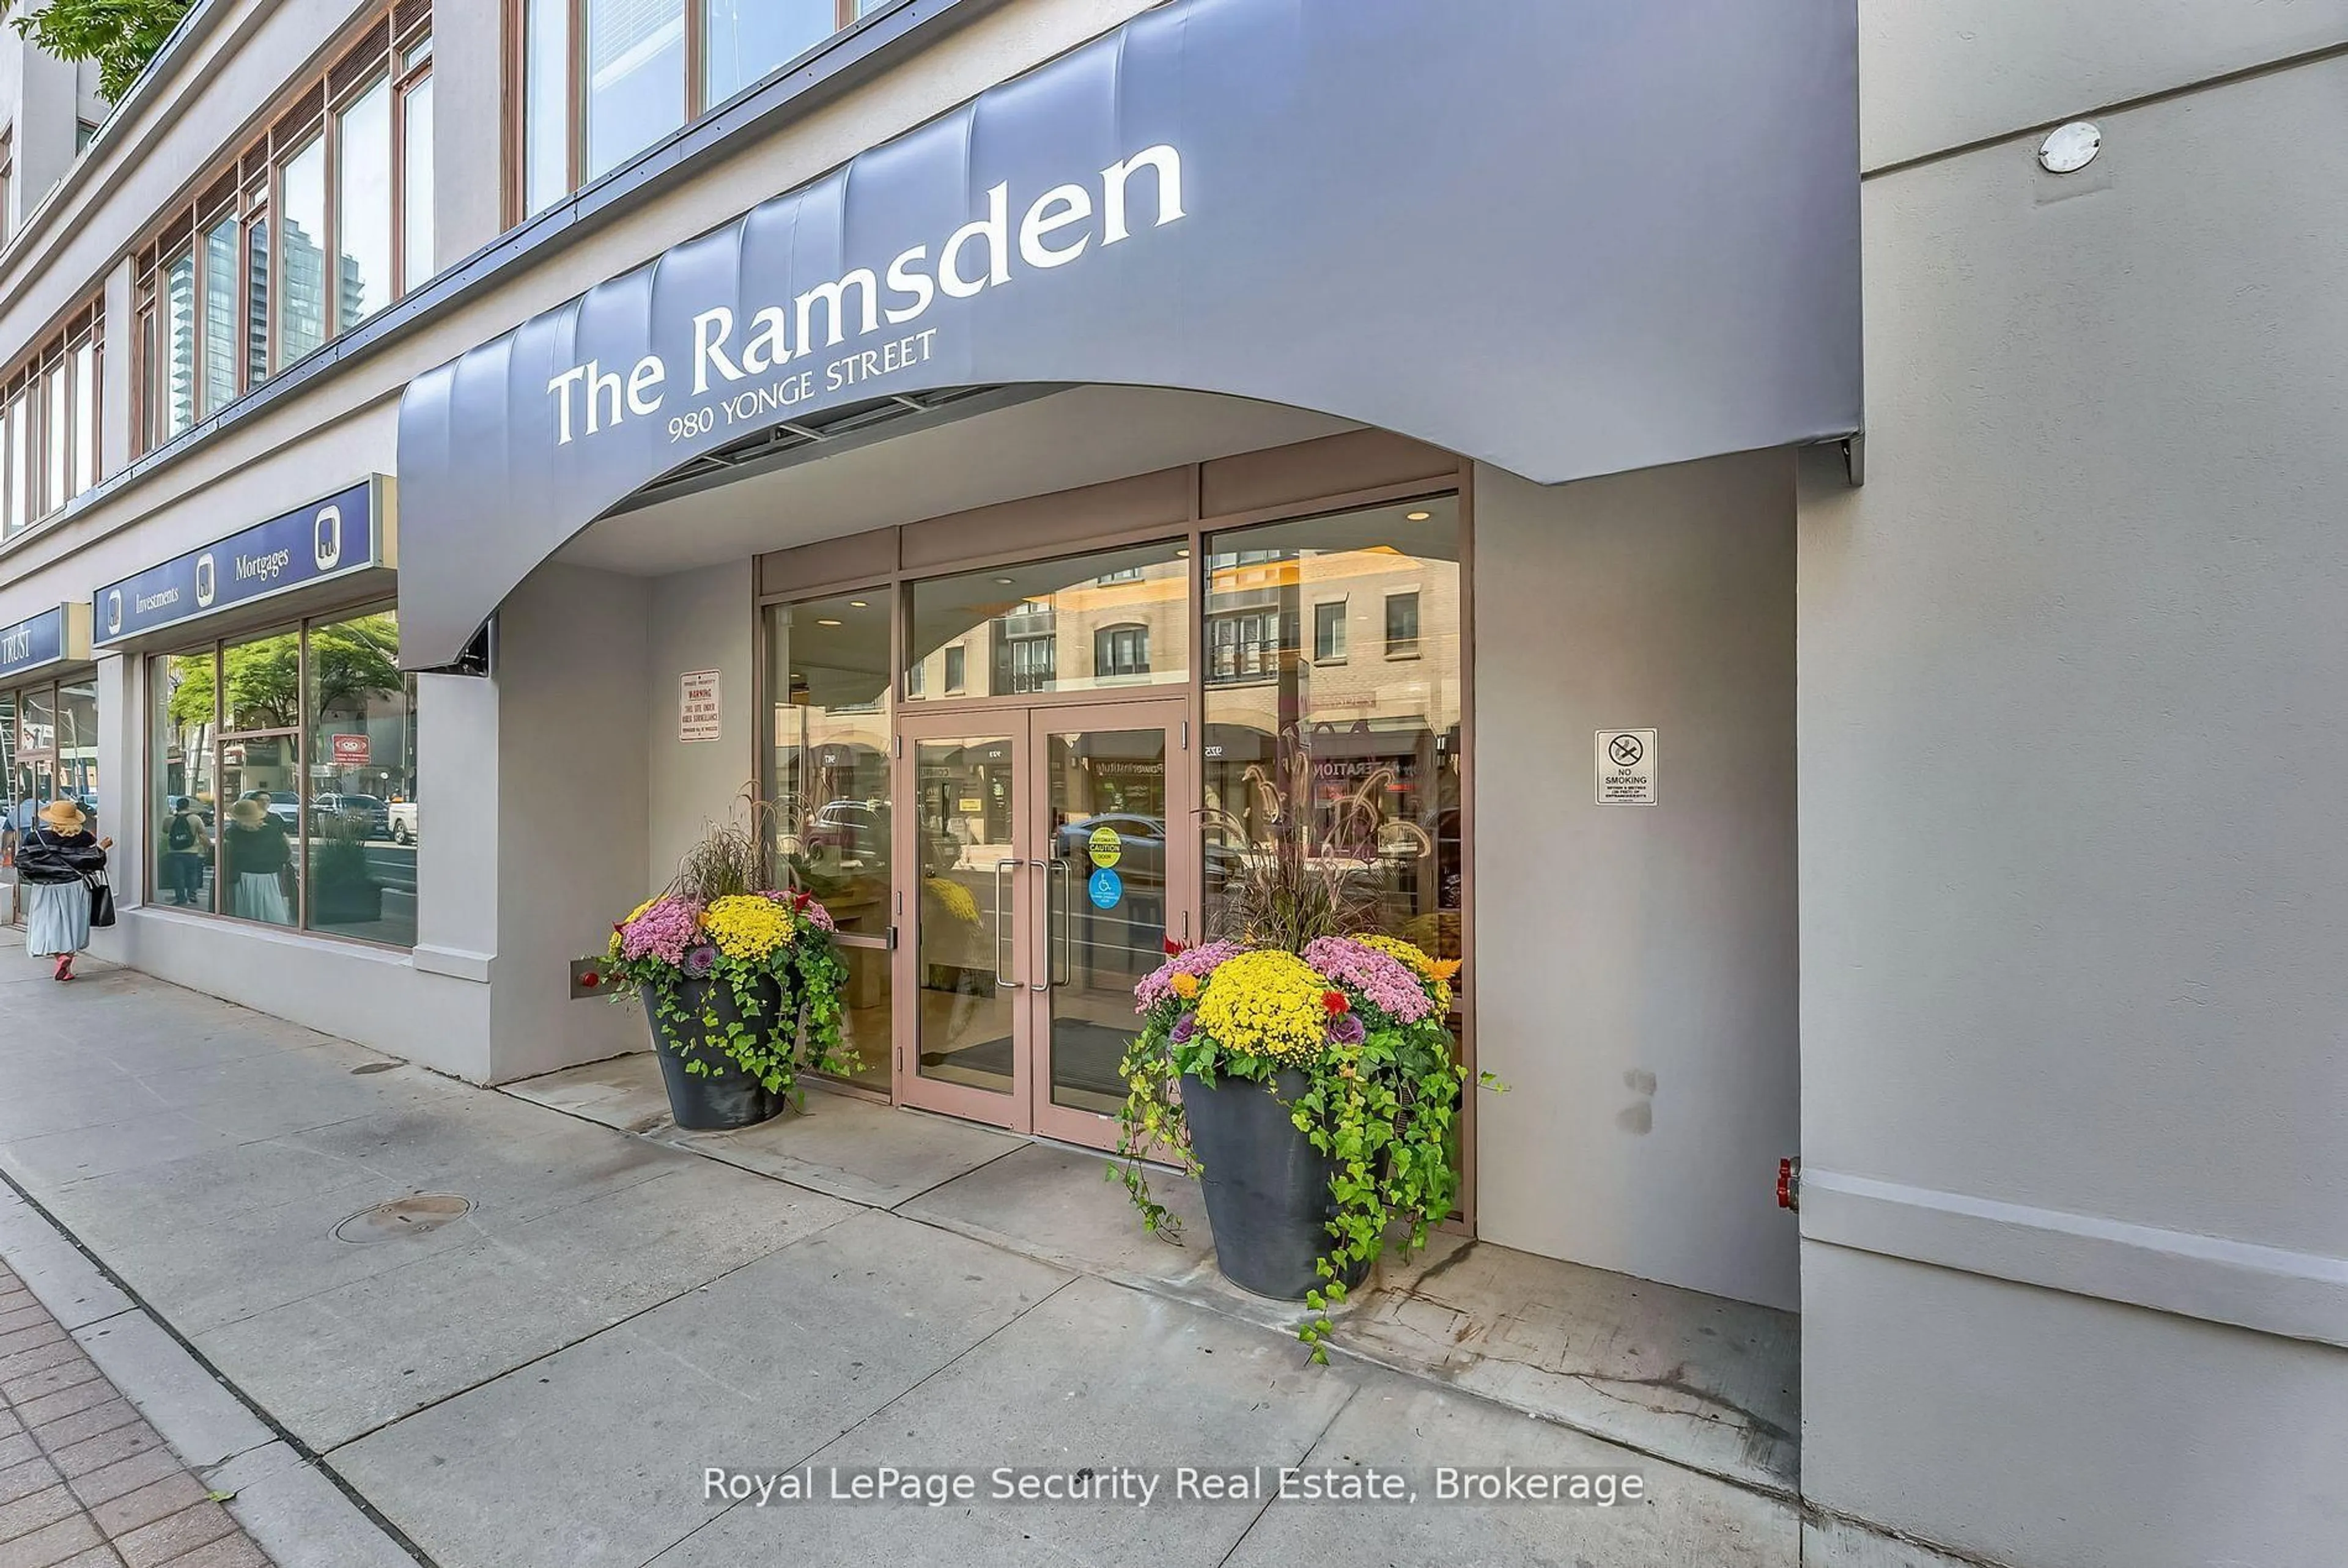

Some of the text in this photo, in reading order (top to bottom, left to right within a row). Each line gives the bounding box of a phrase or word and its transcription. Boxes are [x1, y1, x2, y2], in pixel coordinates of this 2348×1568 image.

[547, 142, 1187, 446] The Ramsden
[667, 328, 939, 444] 980 YONGE STREET
[234, 547, 289, 582] Mortgages
[135, 587, 180, 614] Investments
[1, 628, 31, 664] TRUST
